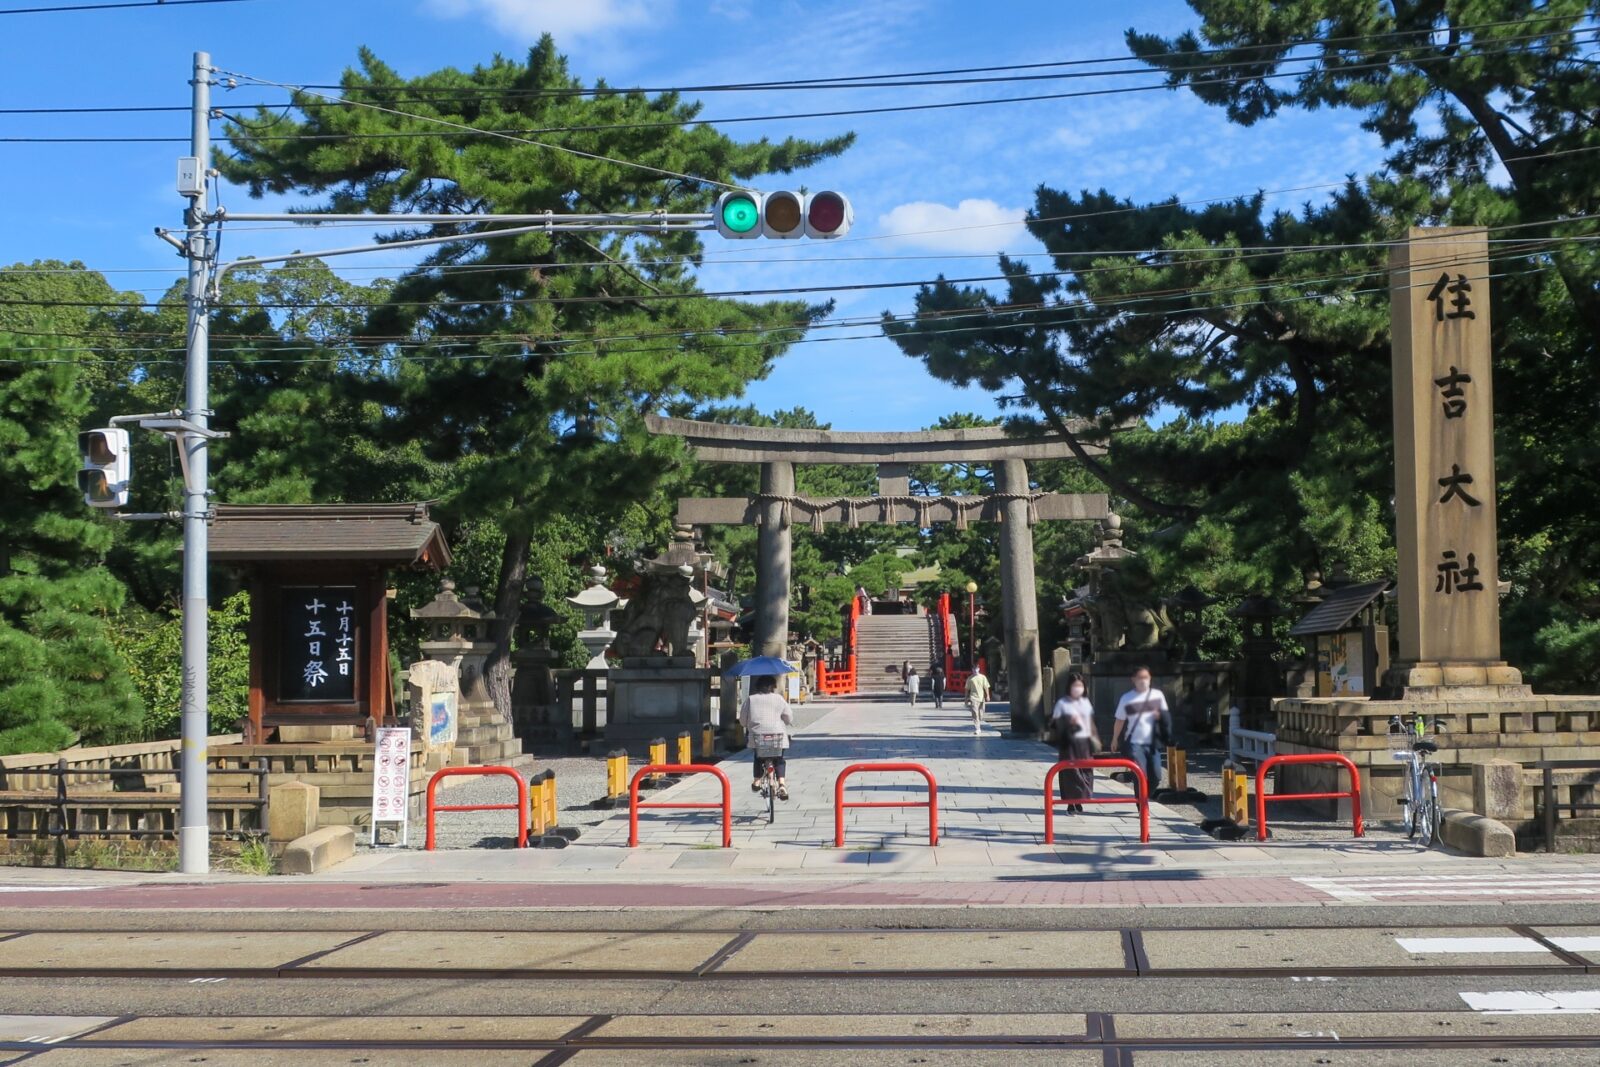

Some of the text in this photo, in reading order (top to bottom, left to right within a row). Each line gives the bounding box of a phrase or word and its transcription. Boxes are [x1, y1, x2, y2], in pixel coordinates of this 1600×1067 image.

[1427, 272, 1484, 594] 住吉大社
[303, 598, 329, 688] 十五日祭
[335, 600, 354, 676] 十月十五日
